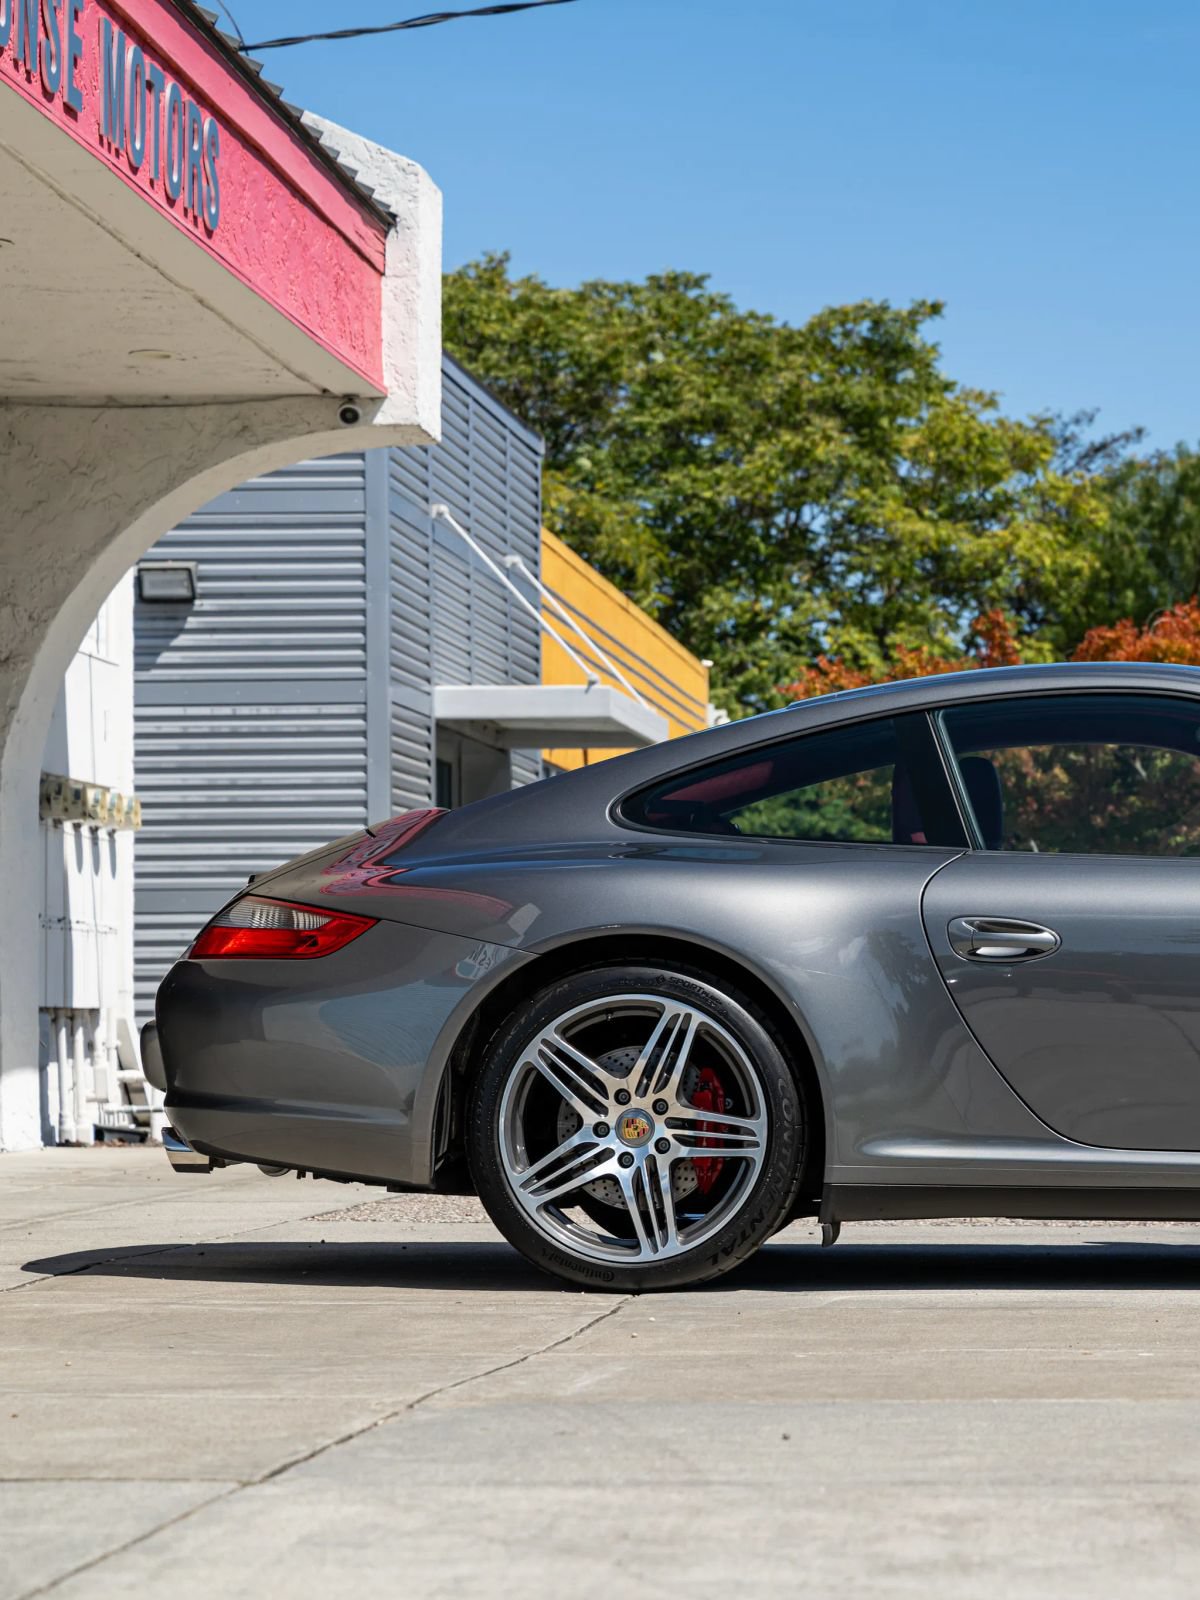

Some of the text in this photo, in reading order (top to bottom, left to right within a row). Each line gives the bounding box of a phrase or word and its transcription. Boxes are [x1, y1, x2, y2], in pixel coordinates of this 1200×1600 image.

[0, 0, 220, 232] NSE MOTORS
[548, 1250, 615, 1282] Continental
[706, 1078, 794, 1266] CONTINENTAL
